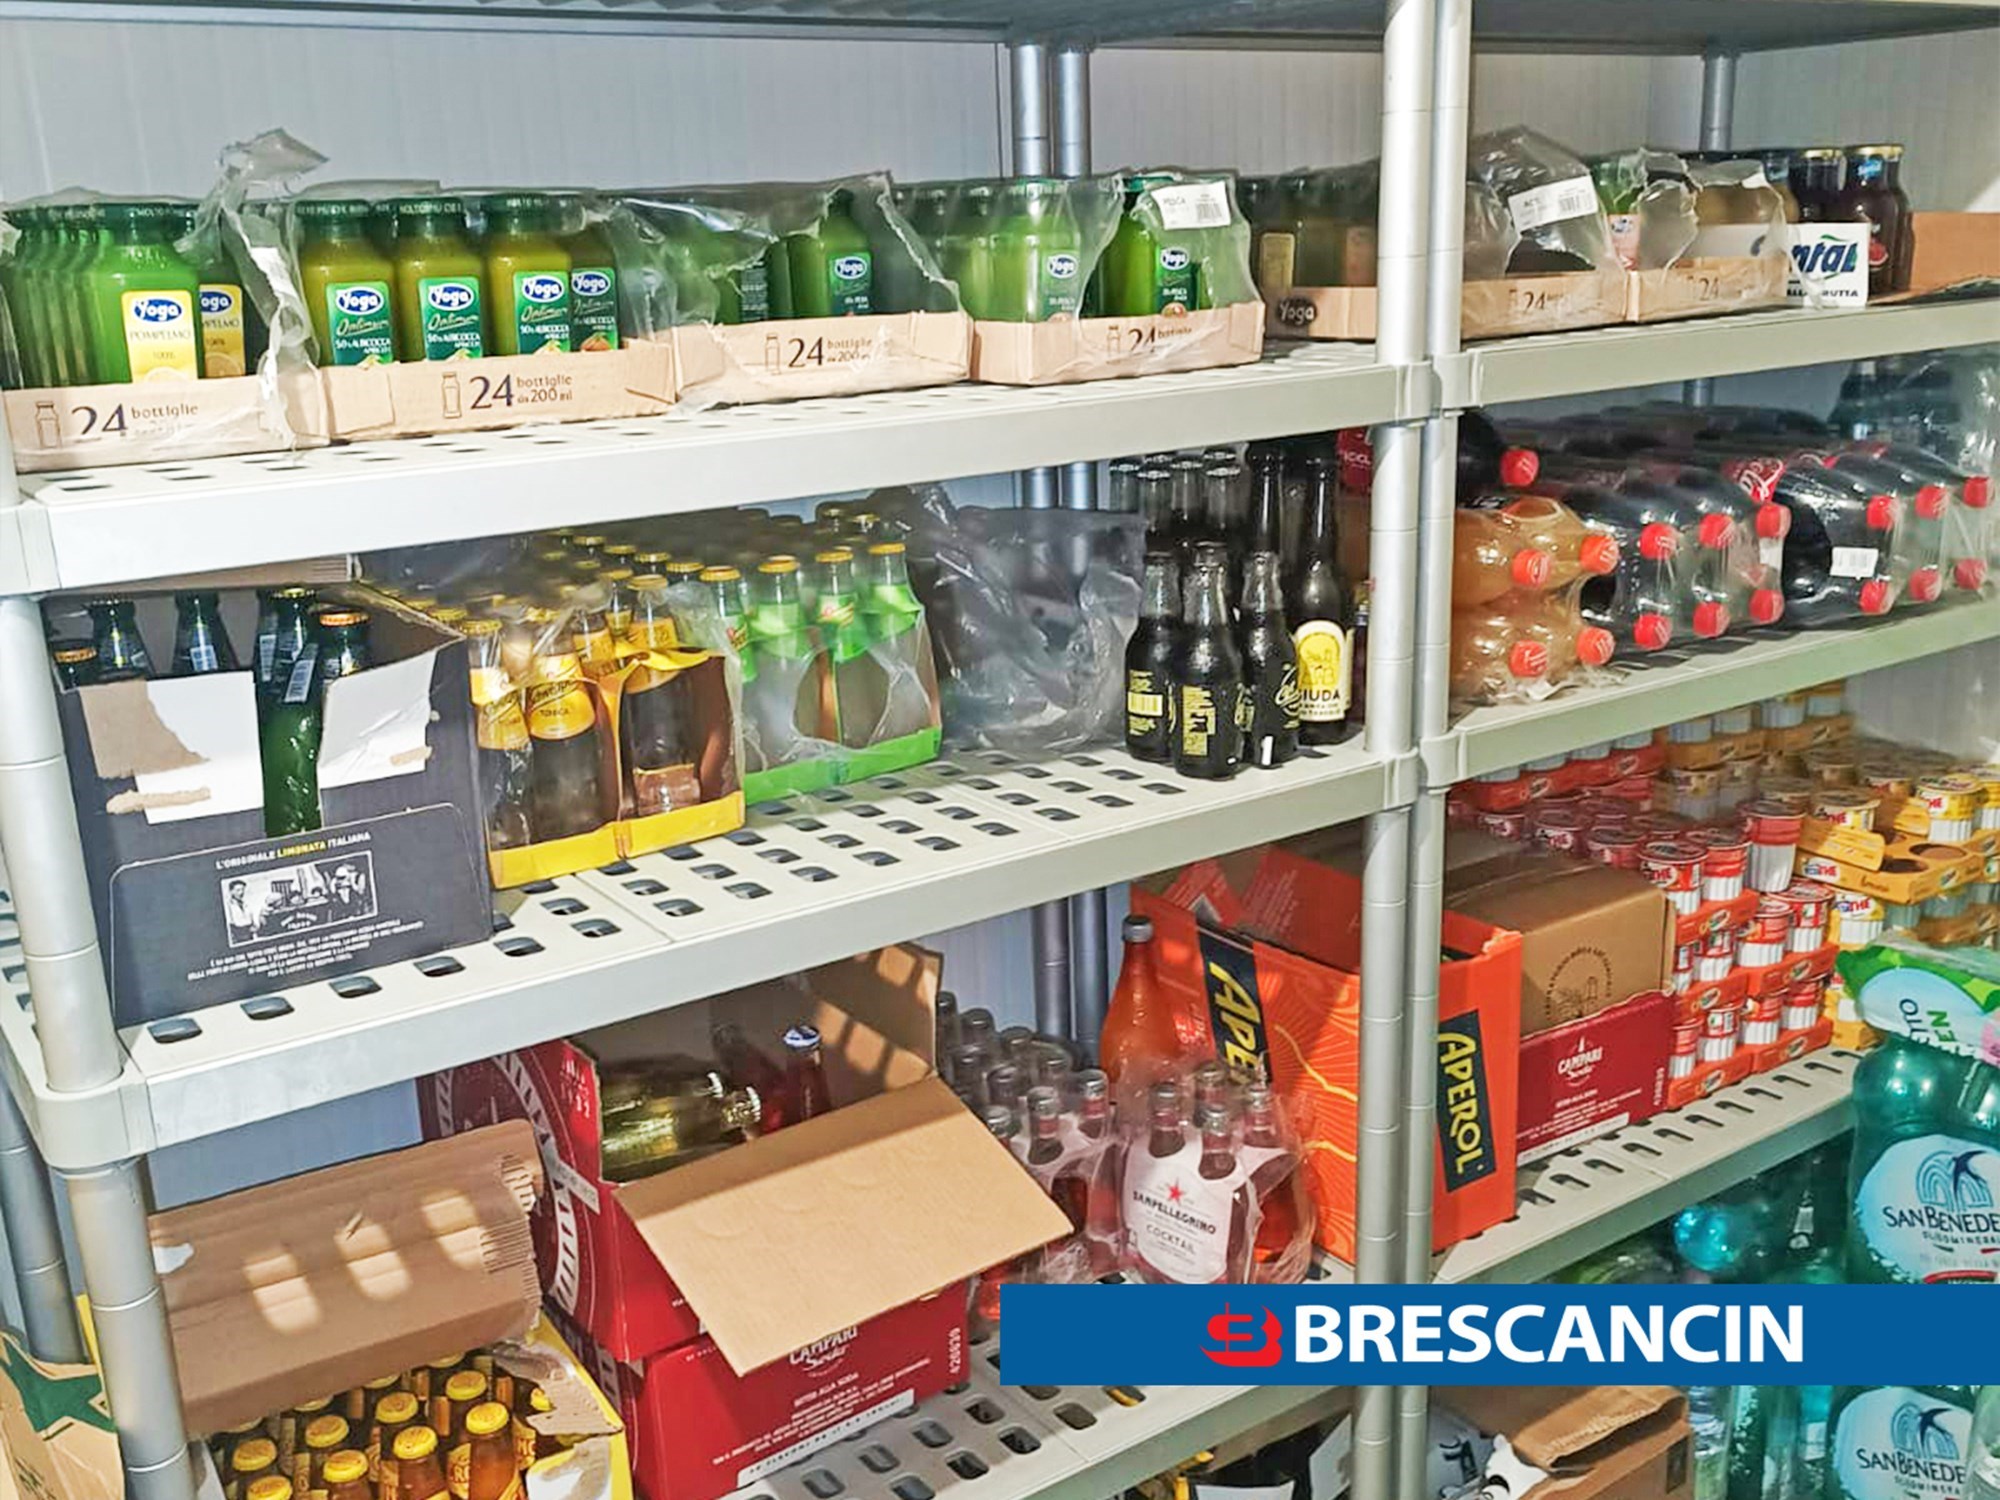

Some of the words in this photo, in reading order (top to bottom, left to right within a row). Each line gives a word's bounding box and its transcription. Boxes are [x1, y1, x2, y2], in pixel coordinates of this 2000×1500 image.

[1790, 241, 1859, 273] ntal
[522, 277, 562, 299] Yoga
[572, 274, 608, 292] Yoga
[336, 290, 380, 311] Yoga
[428, 285, 471, 307] Yoga
[134, 298, 181, 322] Yoga
[1280, 300, 1315, 325] Yoga
[130, 329, 191, 341] POMPELMO
[788, 336, 824, 368] 24
[469, 373, 515, 410] 24
[516, 374, 573, 388] bottiglie
[530, 387, 558, 403] 200
[71, 403, 128, 437] 24
[131, 403, 200, 419] bottiglie
[1299, 689, 1341, 702] IUDA
[327, 832, 372, 849] ITALIANA
[1438, 1032, 1484, 1175] APEROL
[1132, 1190, 1217, 1236] SANPELLEGRINO
